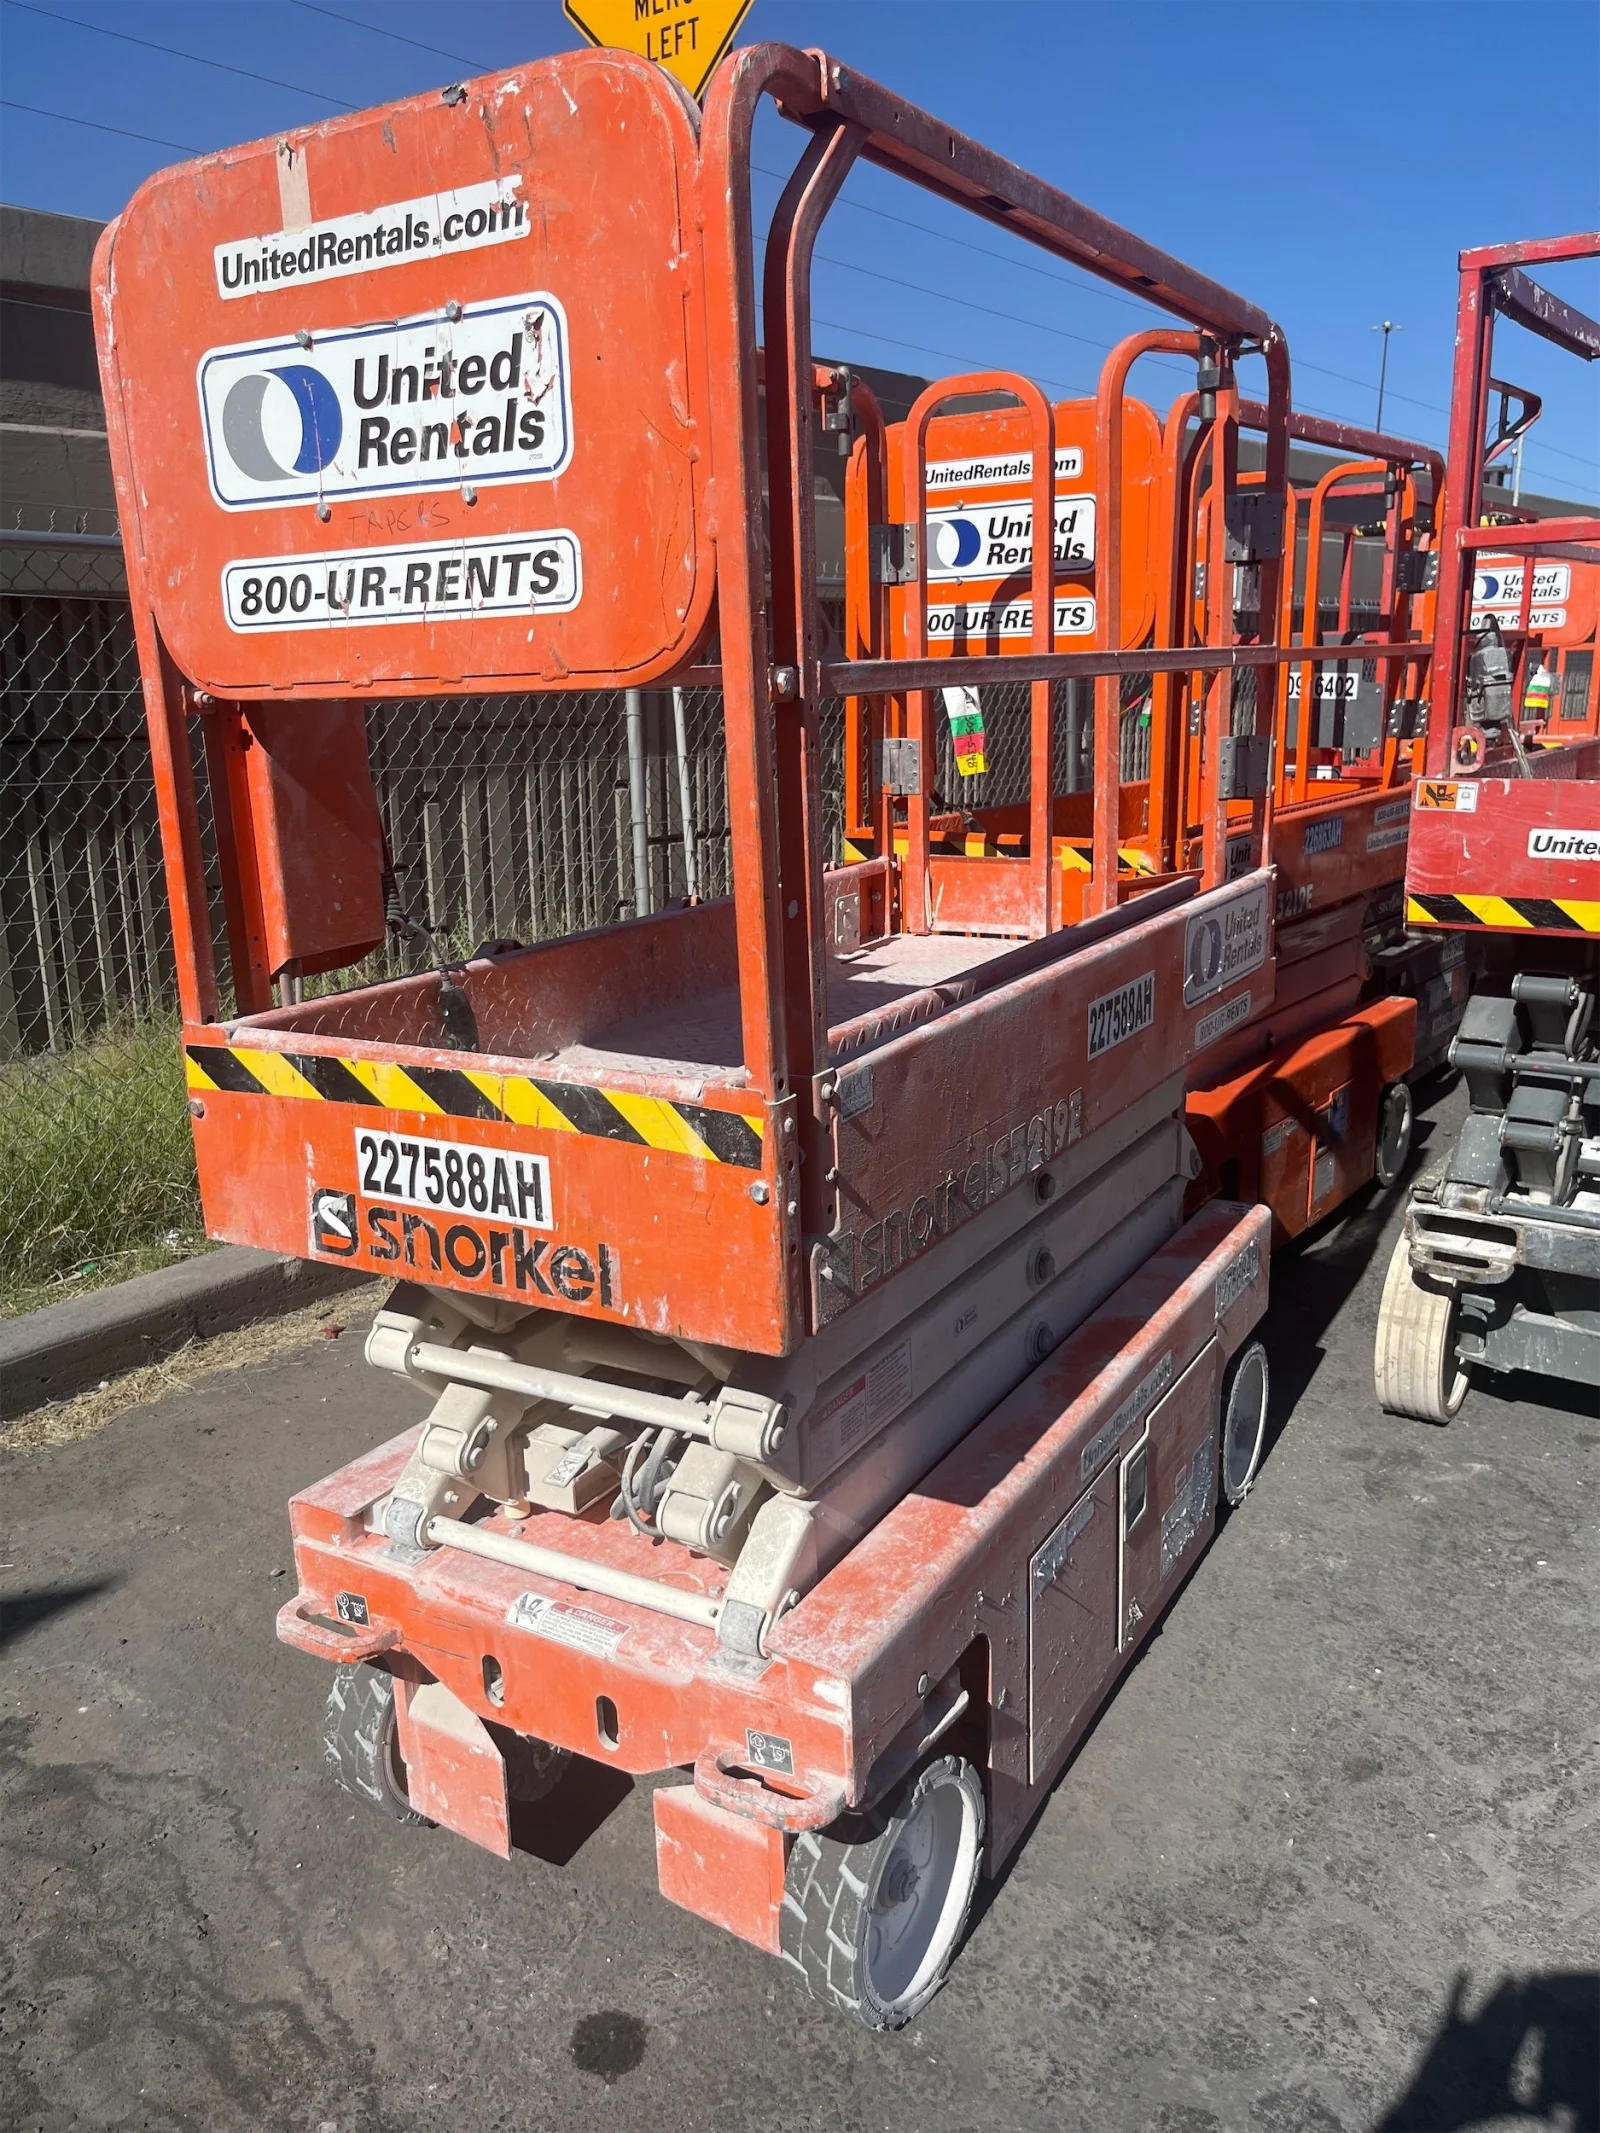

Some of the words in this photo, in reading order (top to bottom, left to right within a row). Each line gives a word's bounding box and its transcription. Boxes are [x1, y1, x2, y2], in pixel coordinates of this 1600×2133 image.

[647, 16, 699, 62] LEFT
[222, 201, 524, 289] UnitedRentals.com
[354, 332, 523, 410] United
[358, 398, 546, 469] Rentals
[988, 509, 1078, 540] Unid
[986, 537, 1086, 565] Renals
[239, 549, 561, 616] 800-UR-RENTS
[1502, 585, 1561, 599] Retals
[1504, 572, 1557, 586] Uned
[928, 606, 1086, 632] 00-UR-RETS
[1230, 844, 1251, 865] Unit
[1533, 835, 1600, 856] Unite
[1225, 905, 1261, 941] United
[1222, 932, 1263, 972] Rentals
[1089, 978, 1153, 1055] 227588AH
[1200, 998, 1248, 1042] 800-UR-RENTS
[360, 1136, 544, 1222] 227588AH
[368, 1206, 613, 1308] snorkel
[574, 1609, 616, 1628] DANGER
